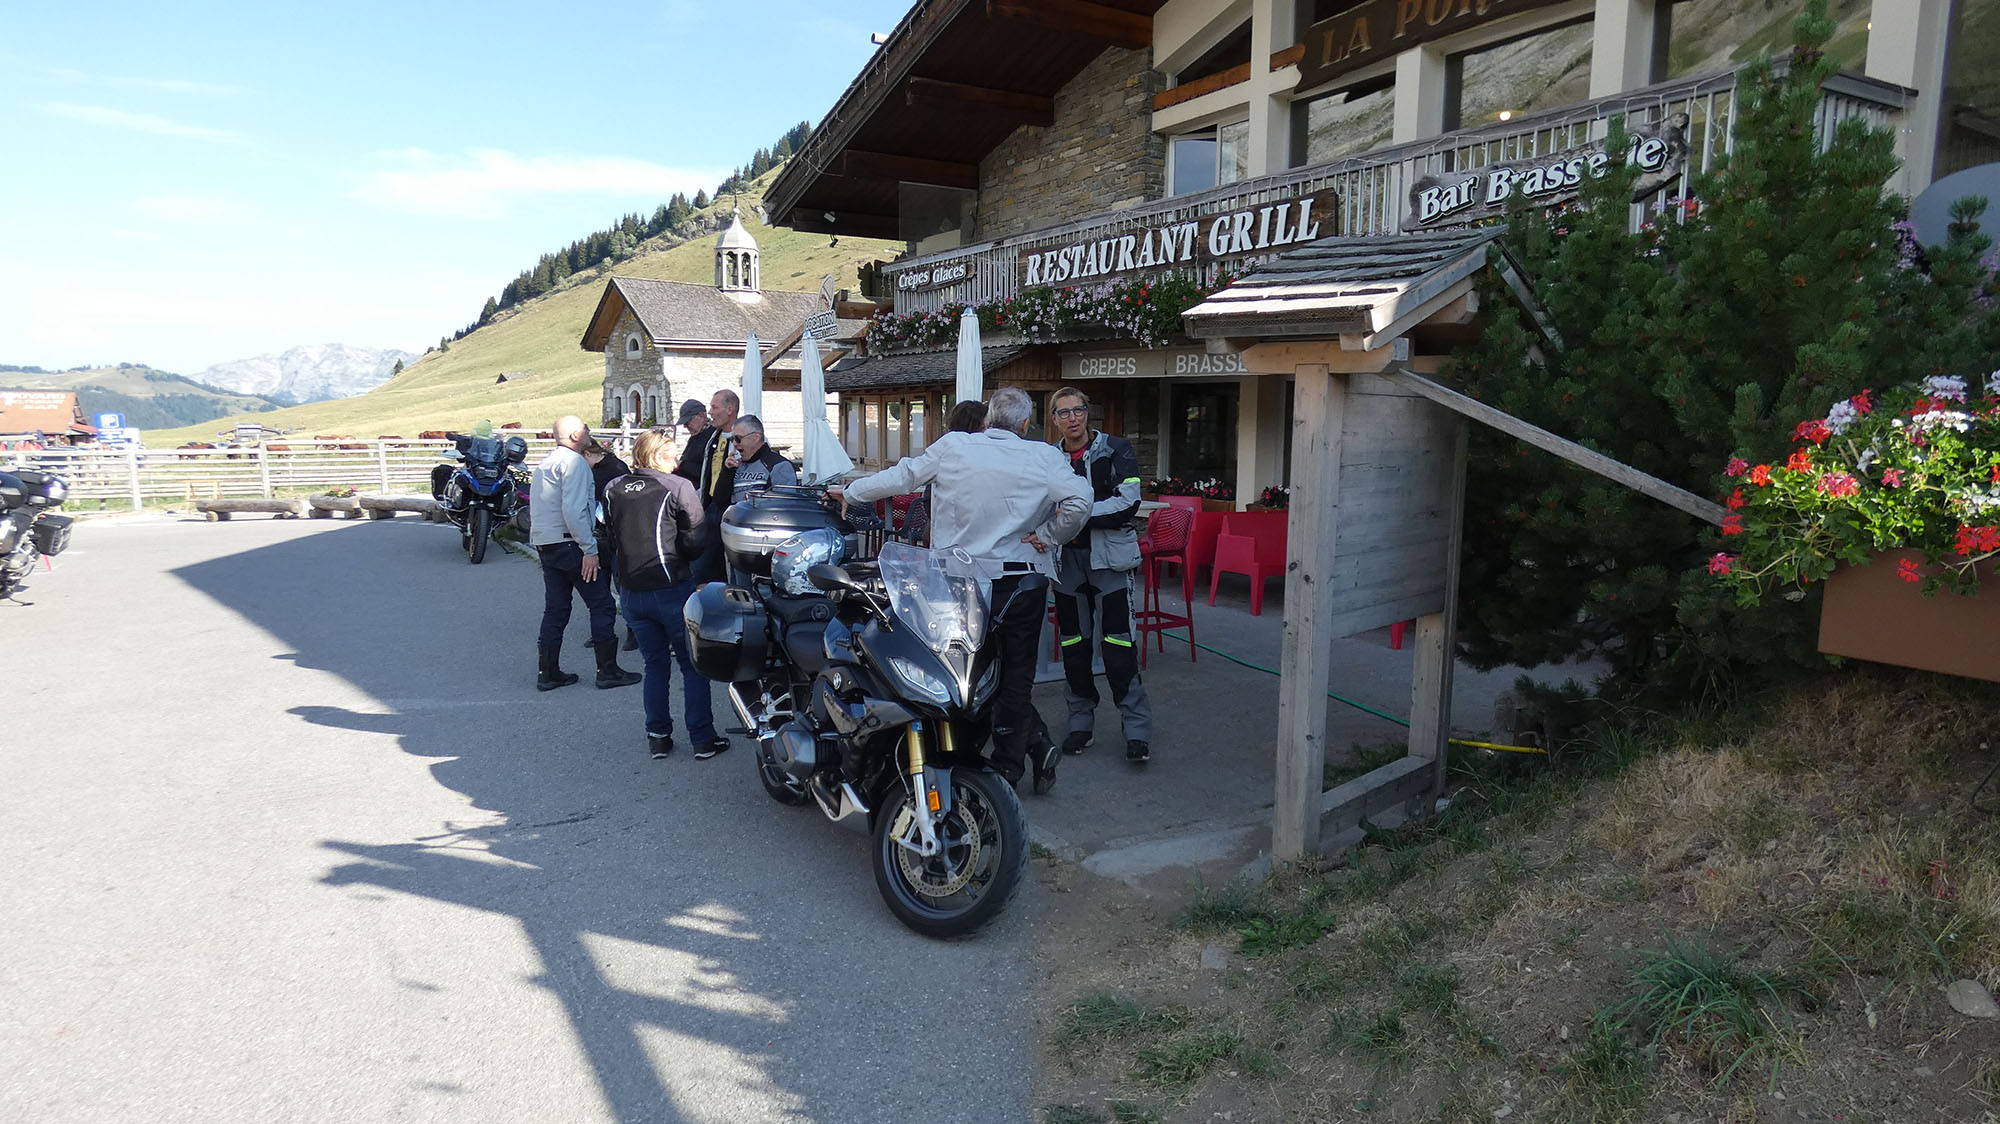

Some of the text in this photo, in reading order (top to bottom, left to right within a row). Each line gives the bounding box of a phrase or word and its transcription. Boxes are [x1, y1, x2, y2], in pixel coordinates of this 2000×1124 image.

[1319, 16, 1372, 69] LA
[1419, 134, 1668, 224] Bar Brasseie
[1024, 197, 1320, 287] RESTAURANT GRILL
[898, 264, 965, 288] Crêpes Glaces
[1079, 357, 1136, 377] CREPES
